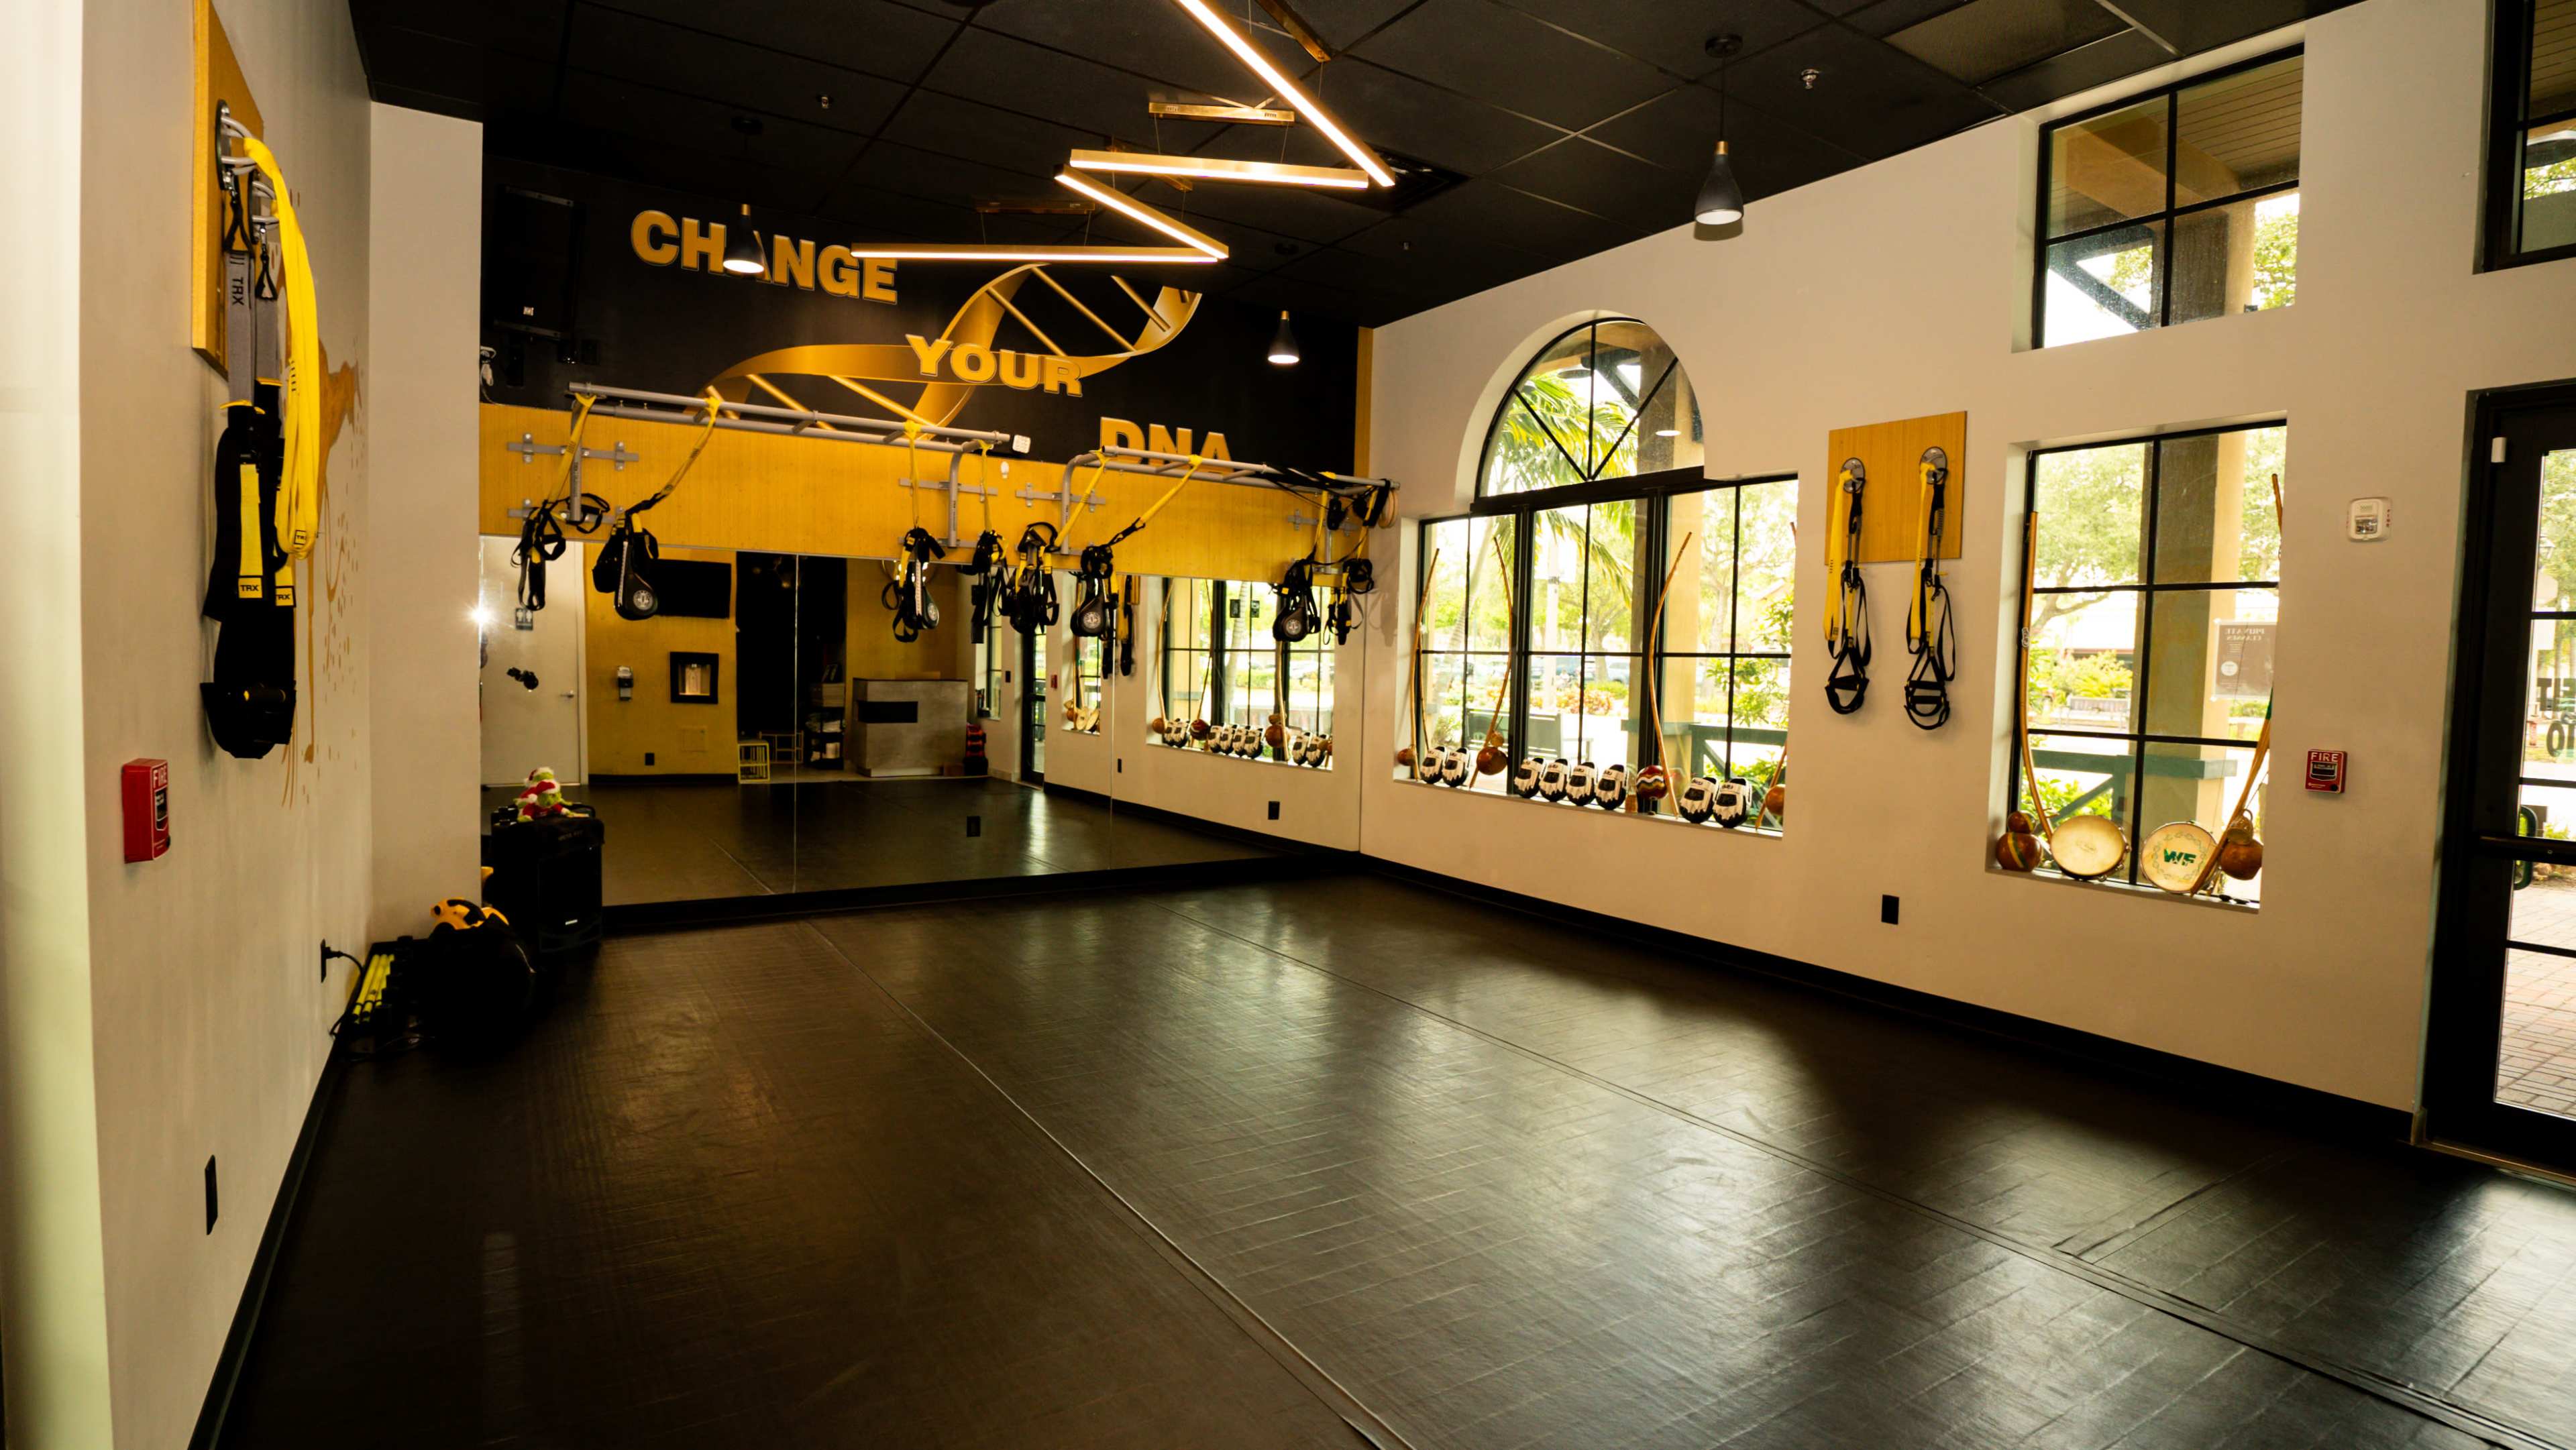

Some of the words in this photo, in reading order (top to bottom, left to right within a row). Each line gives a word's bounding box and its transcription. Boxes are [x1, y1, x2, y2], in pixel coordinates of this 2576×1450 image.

[232, 277, 244, 306] TRX
[905, 333, 1083, 398] YOUR
[1099, 416, 1234, 475] DNA
[2311, 752, 2339, 763] FIRE
[153, 765, 167, 789] FIRE
